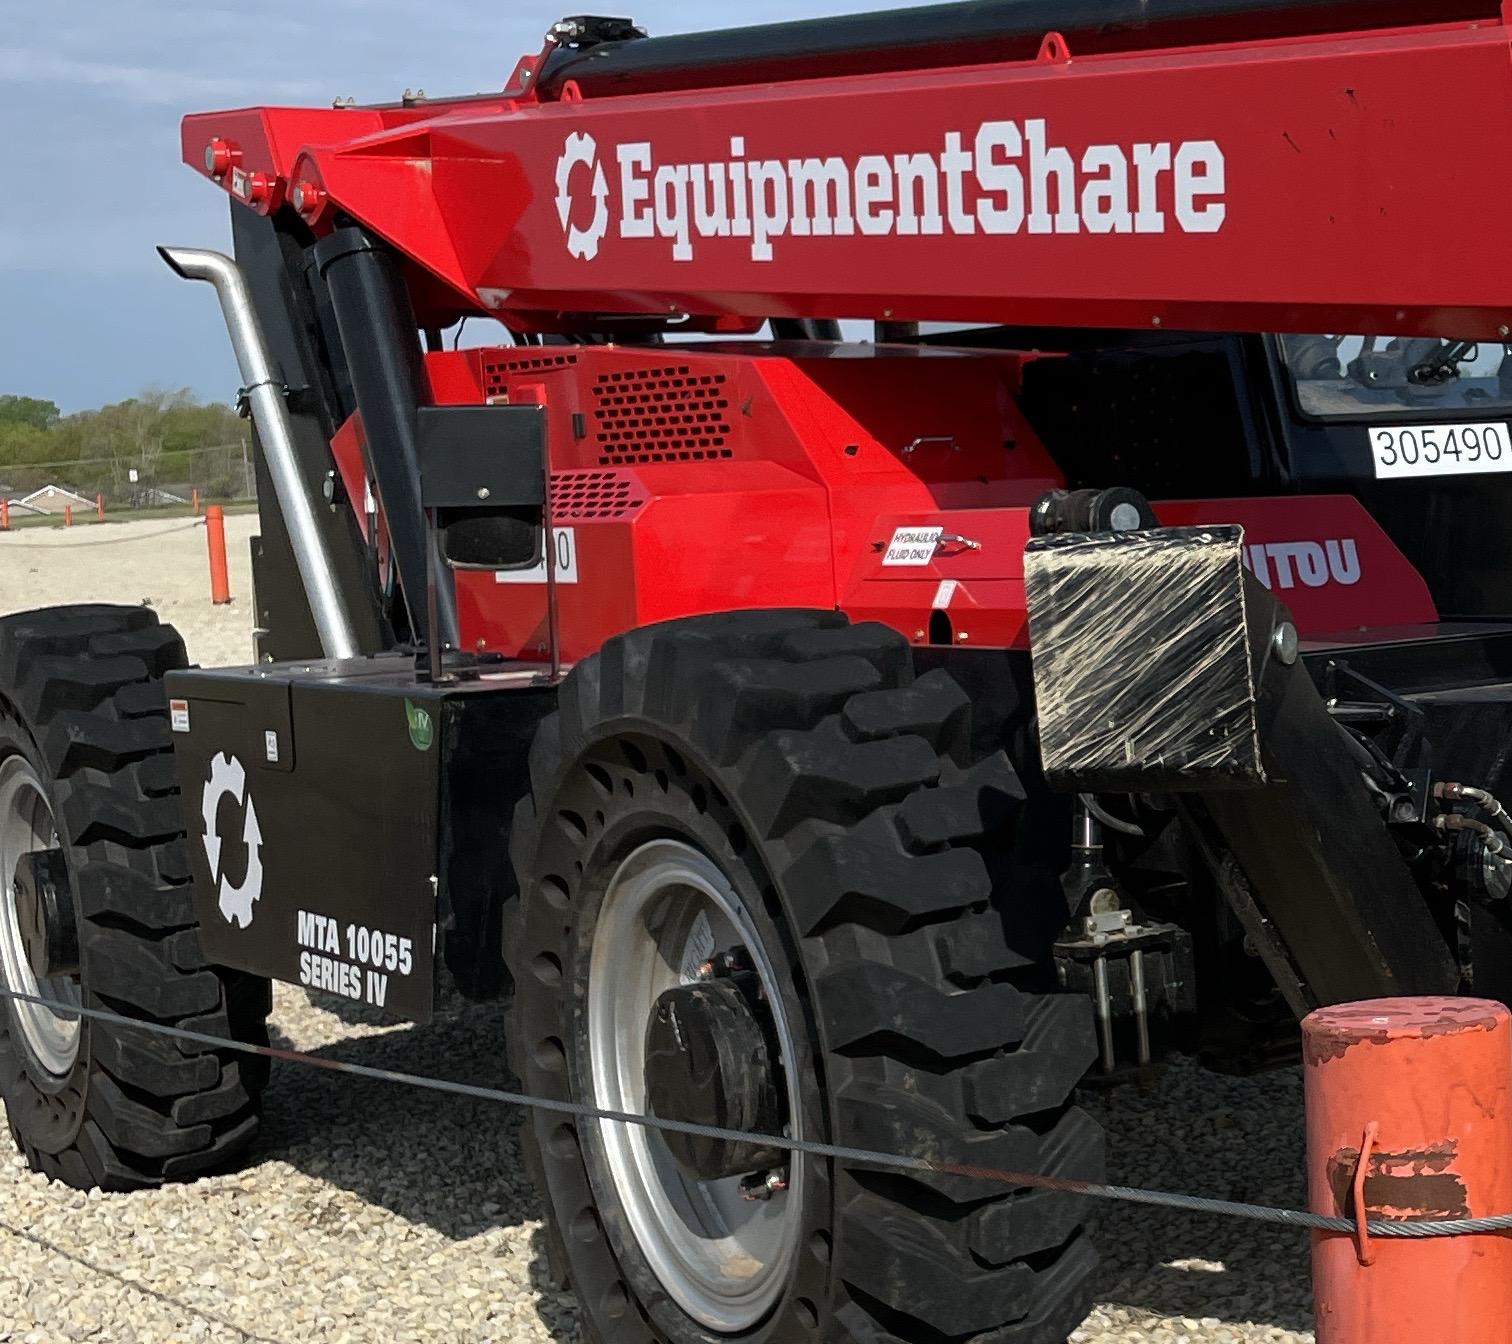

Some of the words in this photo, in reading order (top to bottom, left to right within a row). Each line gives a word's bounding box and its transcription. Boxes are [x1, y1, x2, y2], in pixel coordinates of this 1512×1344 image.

[616, 119, 1226, 262] EquipmentShare
[1376, 427, 1502, 465] 305490
[887, 549, 908, 559] FLUID
[910, 549, 931, 559] ONLY
[297, 909, 341, 956] MTA
[346, 923, 414, 976] 10055
[300, 950, 362, 1001] SERIES
[366, 969, 388, 1008] IV
